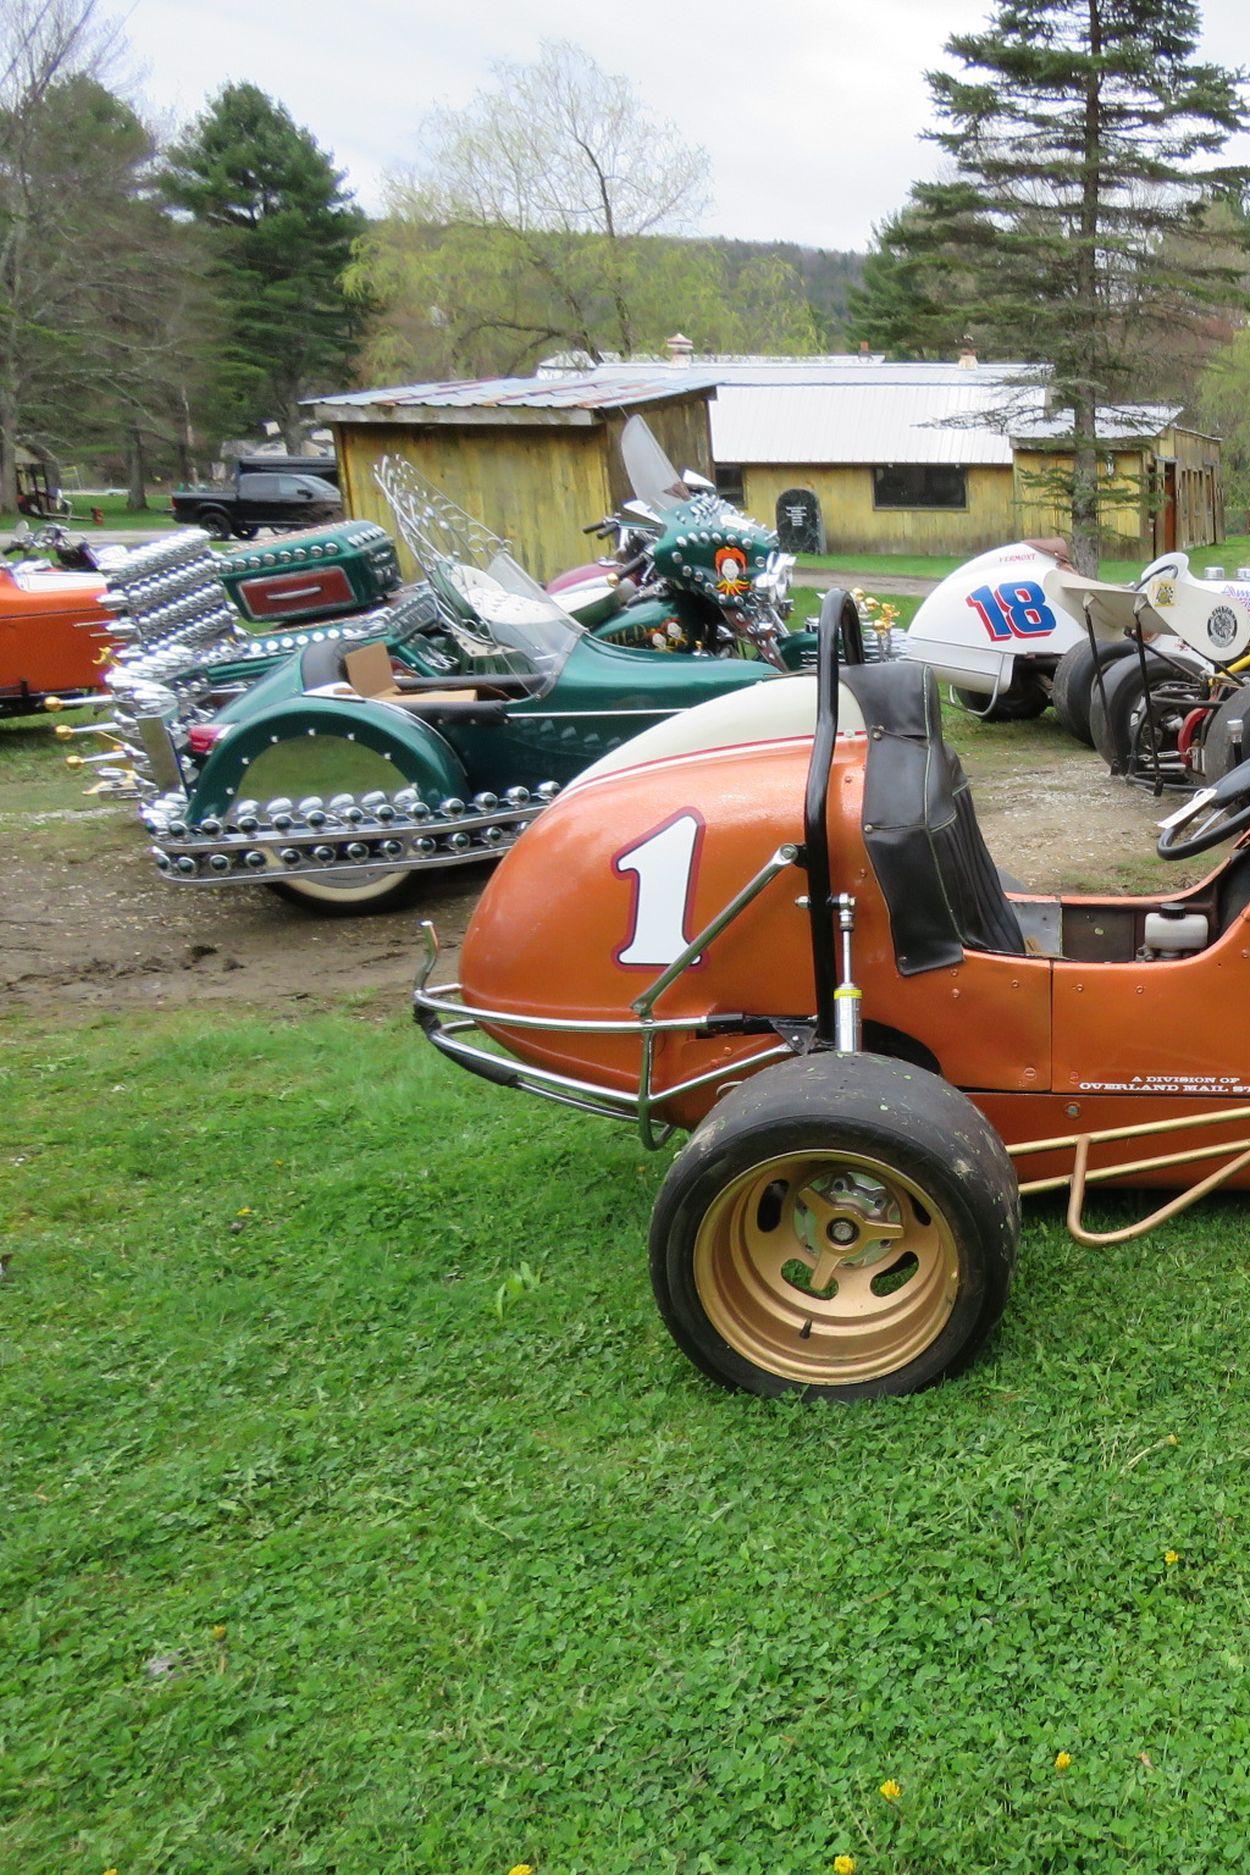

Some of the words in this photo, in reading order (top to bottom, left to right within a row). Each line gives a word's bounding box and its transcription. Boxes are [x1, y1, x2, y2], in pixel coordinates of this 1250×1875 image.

[999, 553, 1036, 562] VERMONT
[965, 581, 1057, 642] 18
[612, 807, 710, 972] 1
[1145, 1076, 1216, 1084] DIVISION
[1079, 1082, 1179, 1091] OVERLAND
